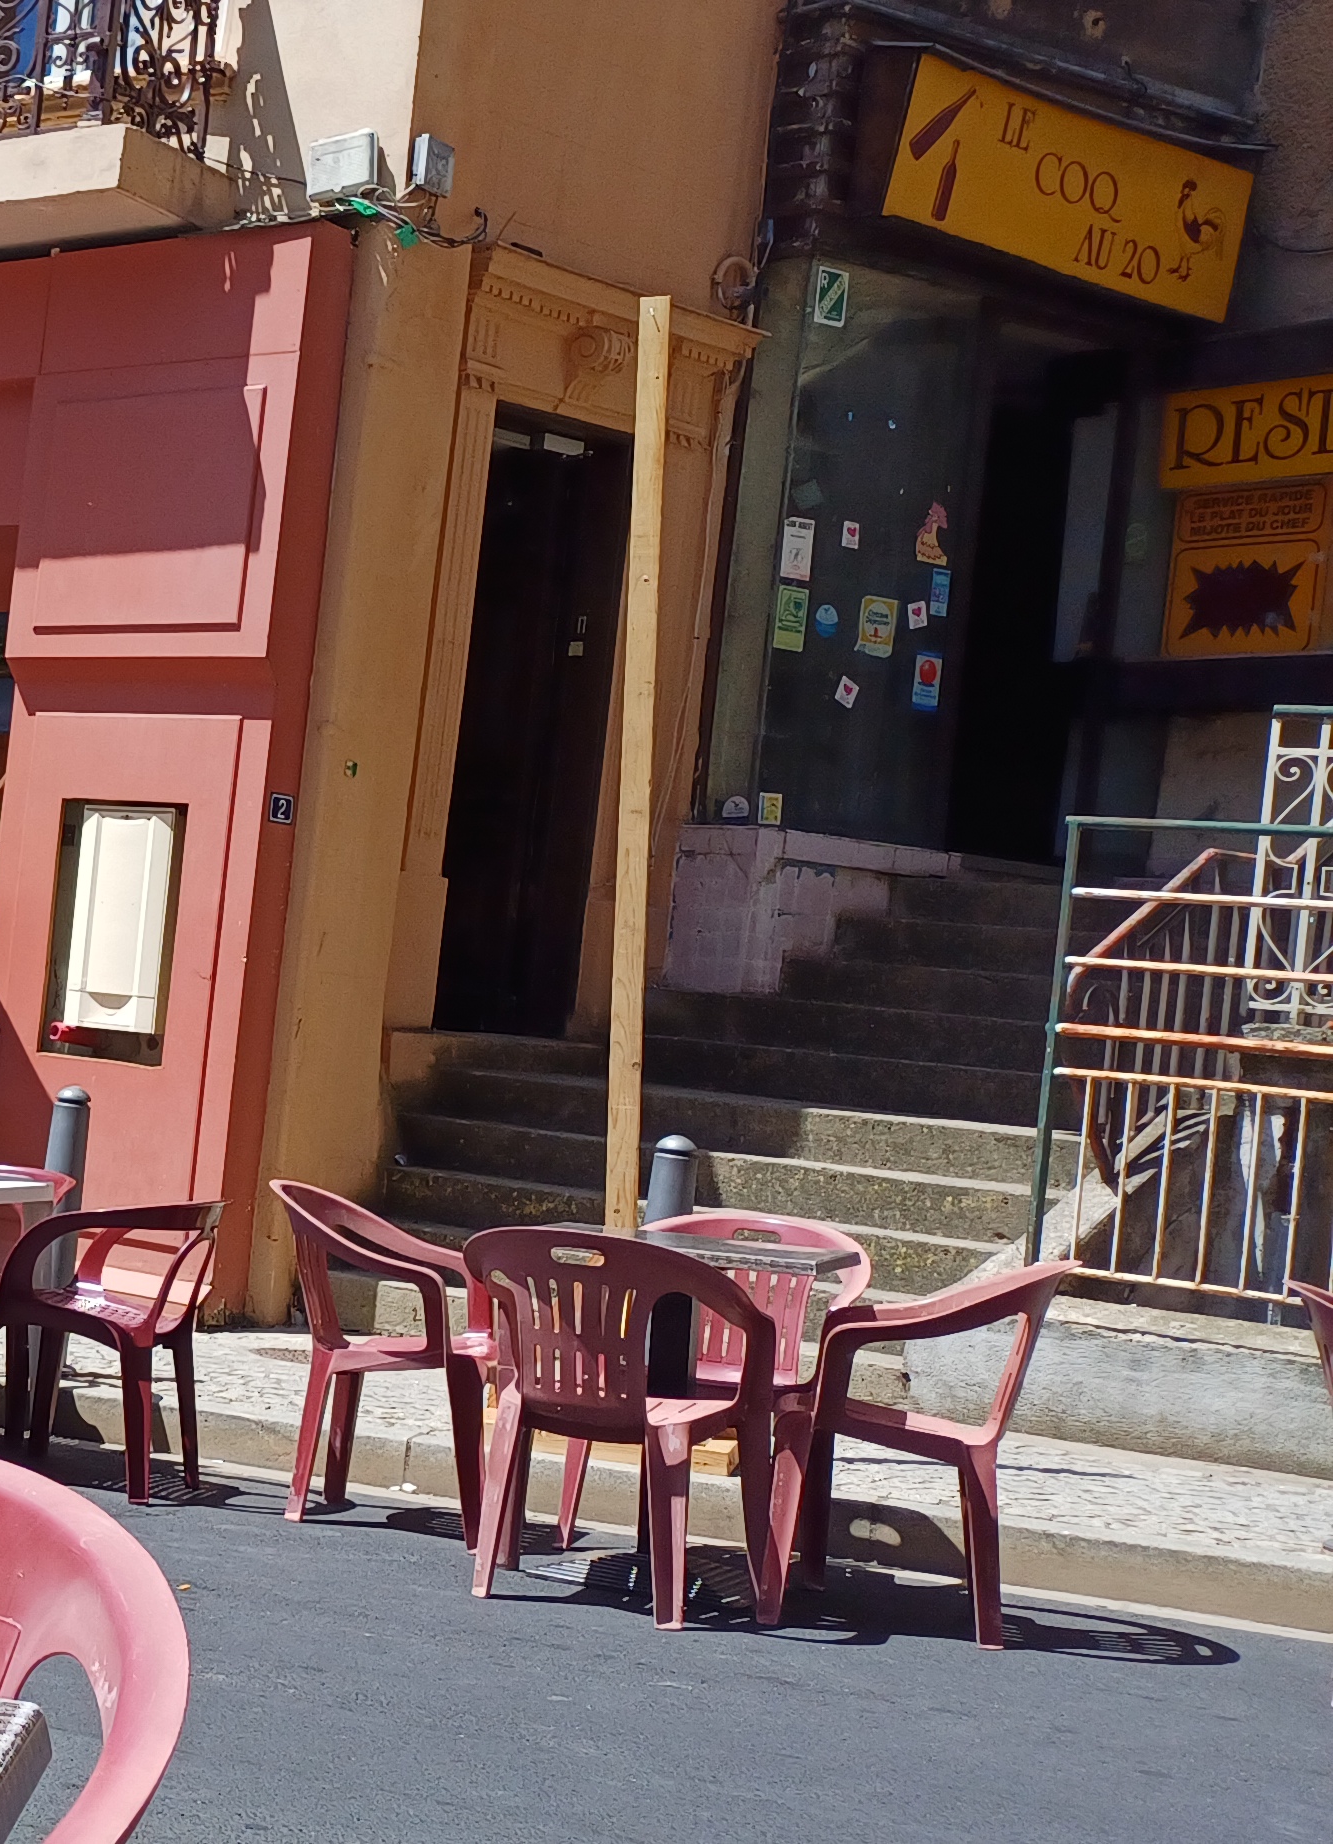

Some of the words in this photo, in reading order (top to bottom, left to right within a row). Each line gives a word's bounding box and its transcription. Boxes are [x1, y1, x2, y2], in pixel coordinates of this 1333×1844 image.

[996, 101, 1037, 154] LE
[1035, 152, 1123, 224] COQ
[1073, 223, 1117, 271] AU
[1119, 238, 1161, 285] 20
[1168, 387, 1333, 472] REST
[1193, 493, 1255, 510] SERVICE
[1257, 488, 1315, 505] RAPIDE
[1210, 508, 1244, 522] PLAT
[1248, 506, 1270, 519] DU
[1272, 502, 1313, 517] JOUR
[1245, 520, 1267, 533] DU
[1270, 516, 1311, 531] CHEF
[277, 799, 287, 819] 2
